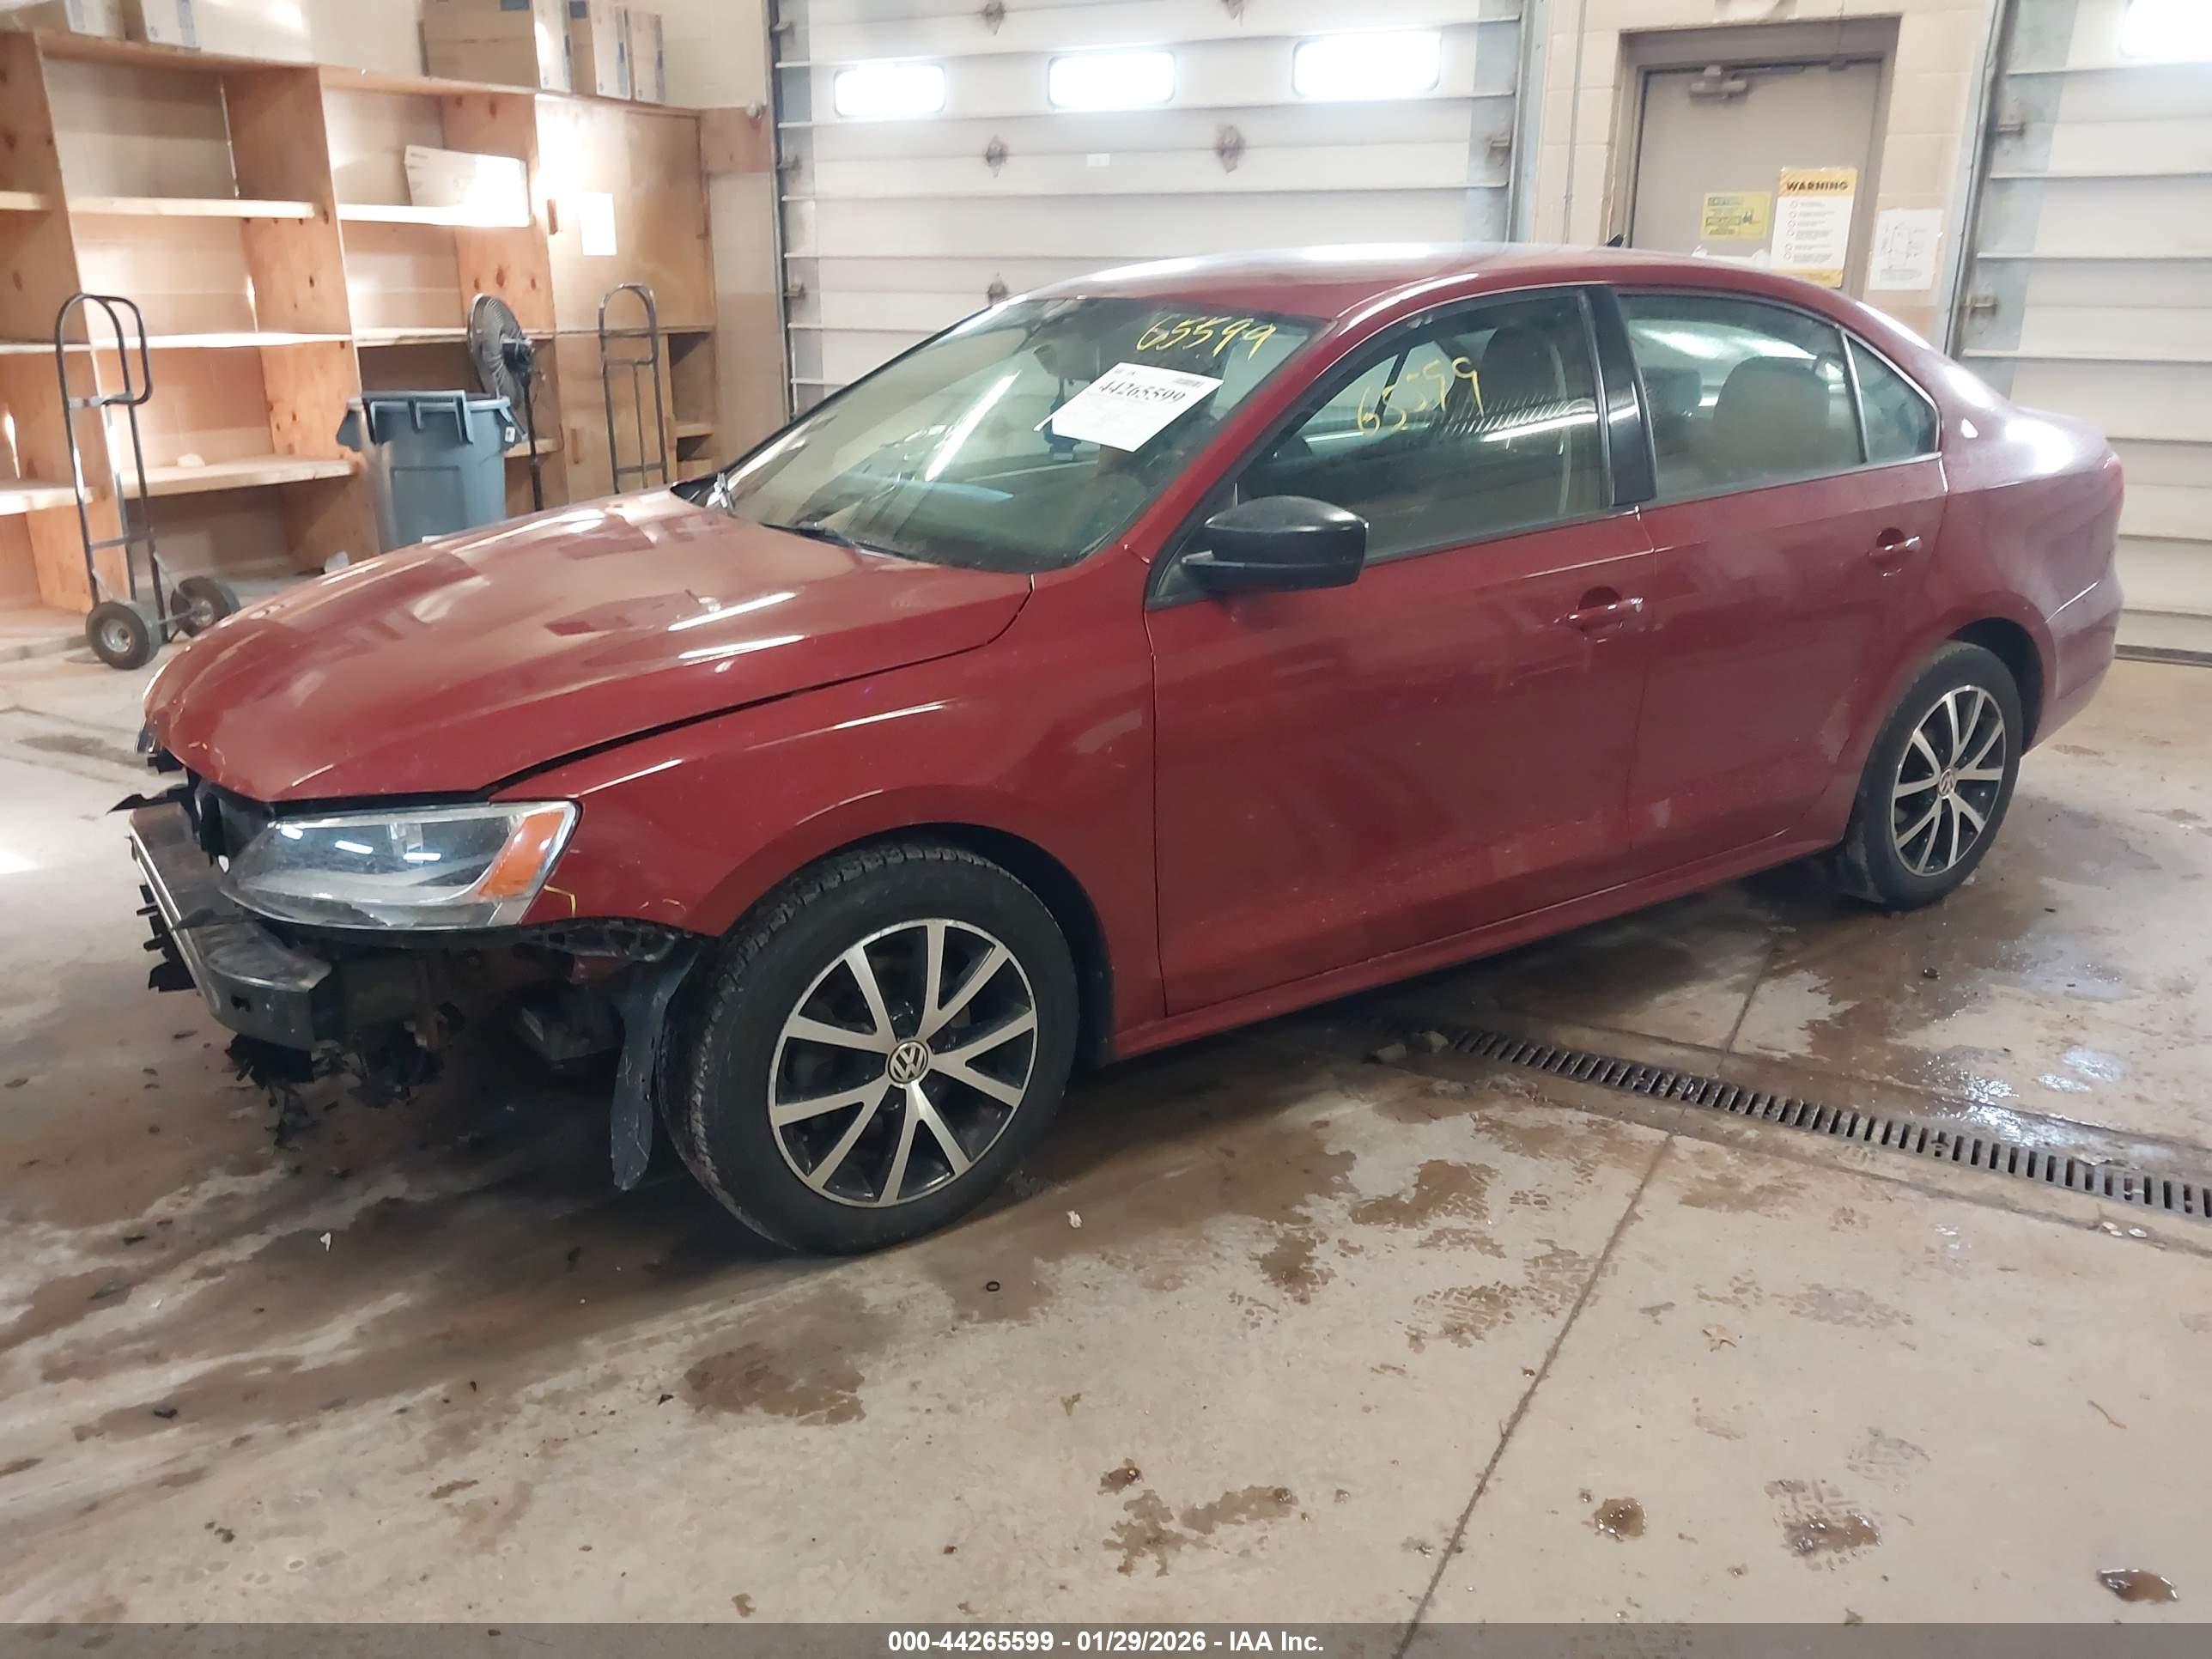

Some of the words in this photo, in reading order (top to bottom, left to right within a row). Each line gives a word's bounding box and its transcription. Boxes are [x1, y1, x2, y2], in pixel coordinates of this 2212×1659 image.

[1786, 181, 1848, 191] WARNING
[1136, 314, 1277, 361] 65599
[1099, 380, 1186, 403] 44265599
